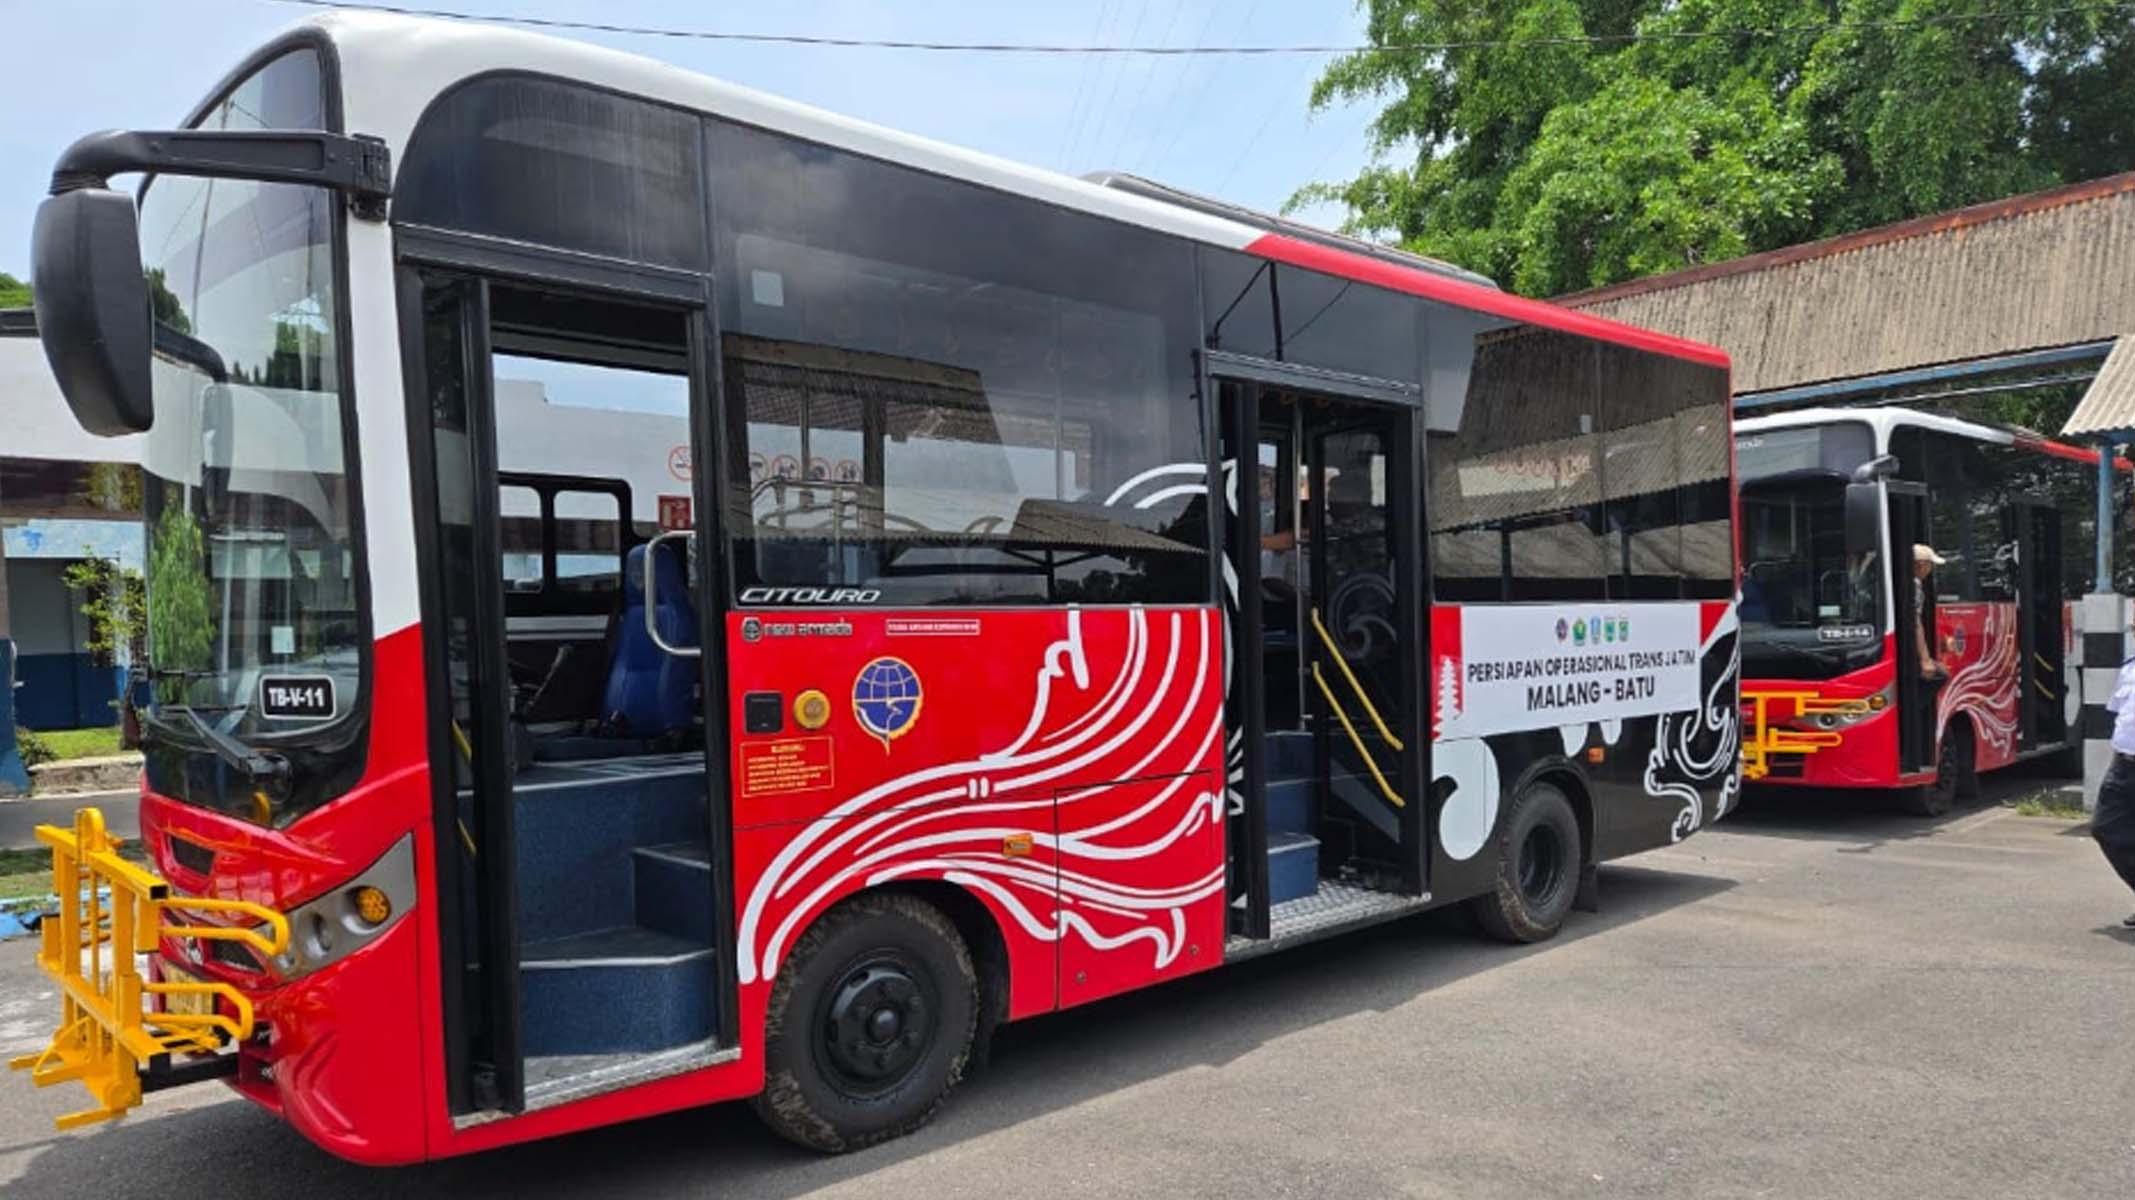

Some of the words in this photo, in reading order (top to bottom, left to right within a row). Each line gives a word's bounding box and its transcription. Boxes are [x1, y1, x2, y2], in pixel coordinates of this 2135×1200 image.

[740, 587, 881, 603] CITOURO
[1467, 660, 1543, 683] PERSIAPAN
[1545, 654, 1627, 676] OPERASIONAL
[1628, 651, 1664, 670] TRANS
[268, 687, 324, 707] TB-V-11
[1527, 680, 1601, 711] MALANG
[1615, 676, 1656, 701] BATU
